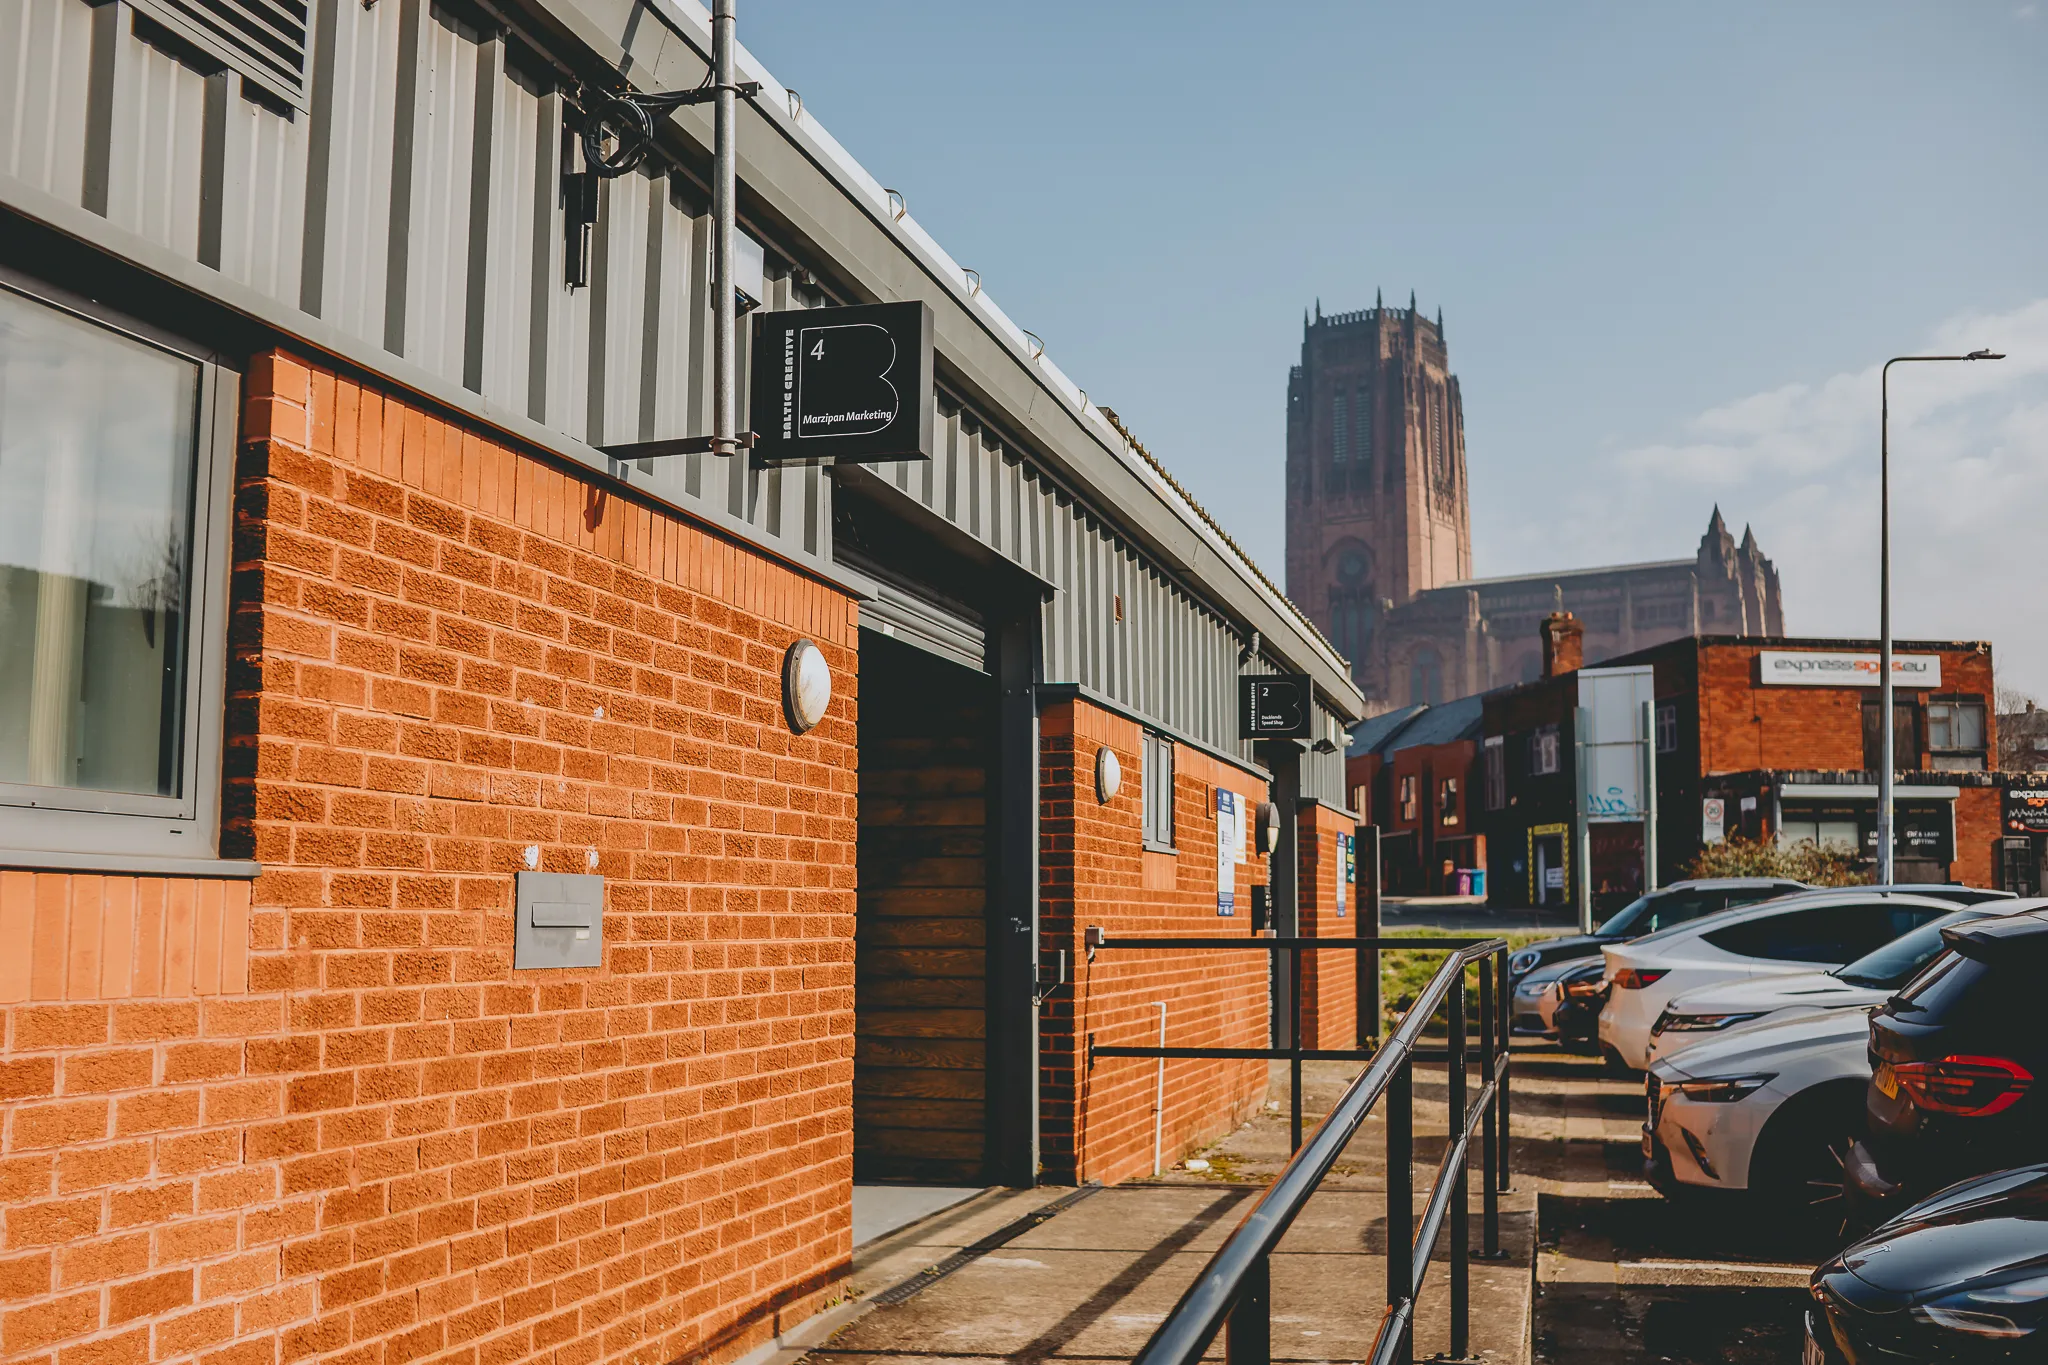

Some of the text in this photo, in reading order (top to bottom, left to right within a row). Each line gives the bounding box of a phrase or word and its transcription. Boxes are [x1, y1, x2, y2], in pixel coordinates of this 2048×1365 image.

[810, 338, 825, 361] 4
[783, 329, 794, 439] BALTIC CREATIVE
[803, 409, 892, 425] Marzipan Marketing
[1262, 687, 1269, 697] 2
